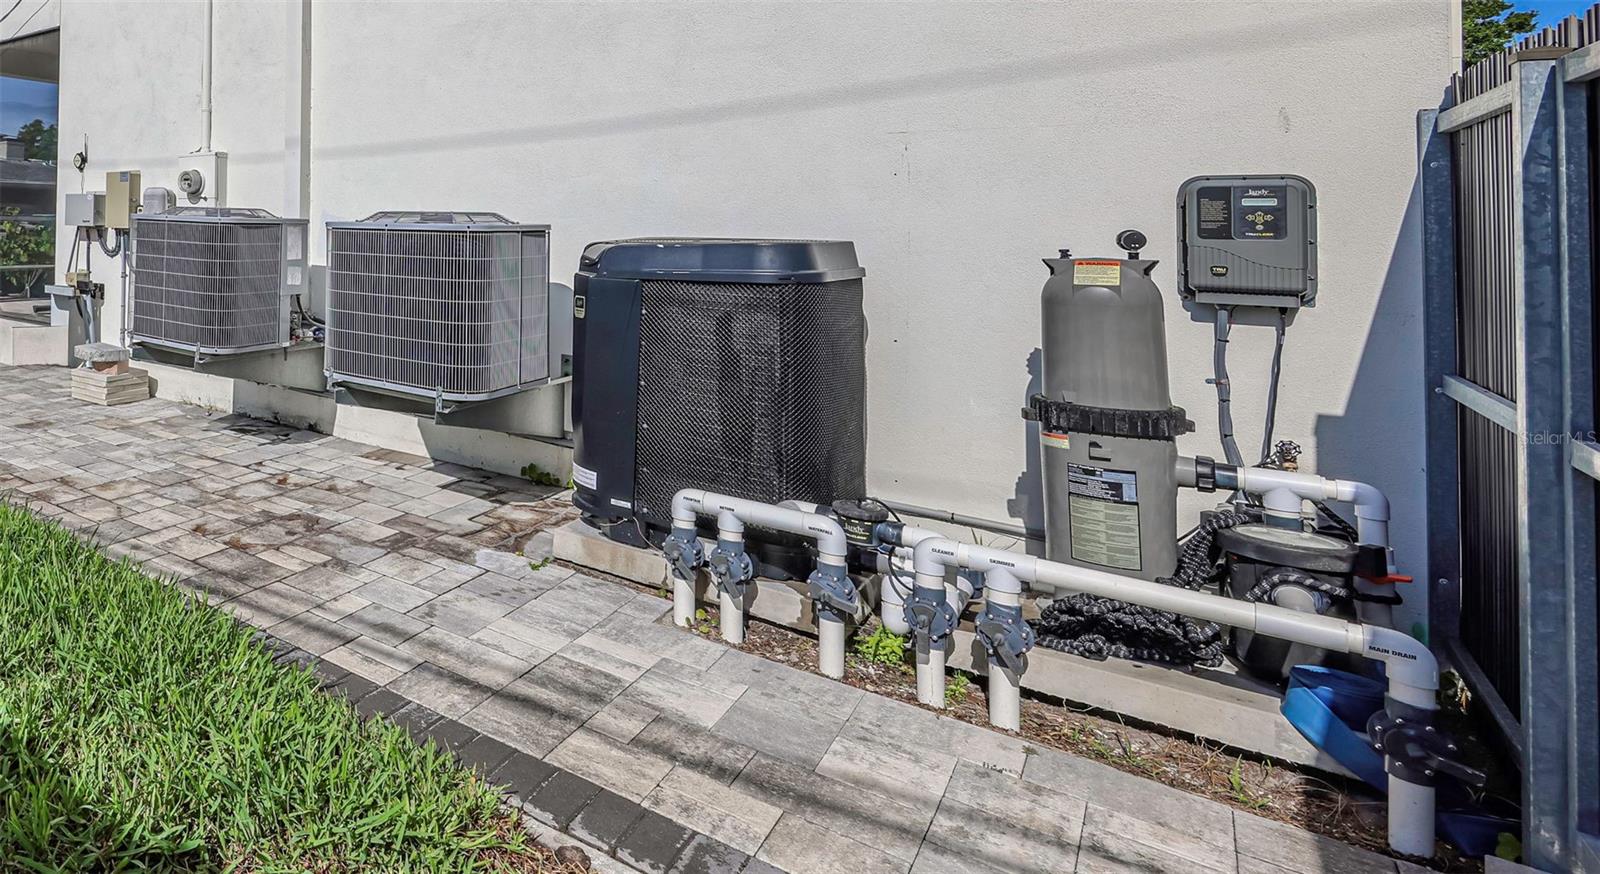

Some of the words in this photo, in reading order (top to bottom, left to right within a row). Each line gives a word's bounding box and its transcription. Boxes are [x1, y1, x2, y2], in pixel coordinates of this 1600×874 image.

[808, 526, 833, 535] WATERFALL
[931, 547, 955, 556] CLEANER
[989, 558, 1016, 568] SKIMMER
[1368, 645, 1390, 654] MAIN
[1391, 650, 1417, 660] DRAIN
